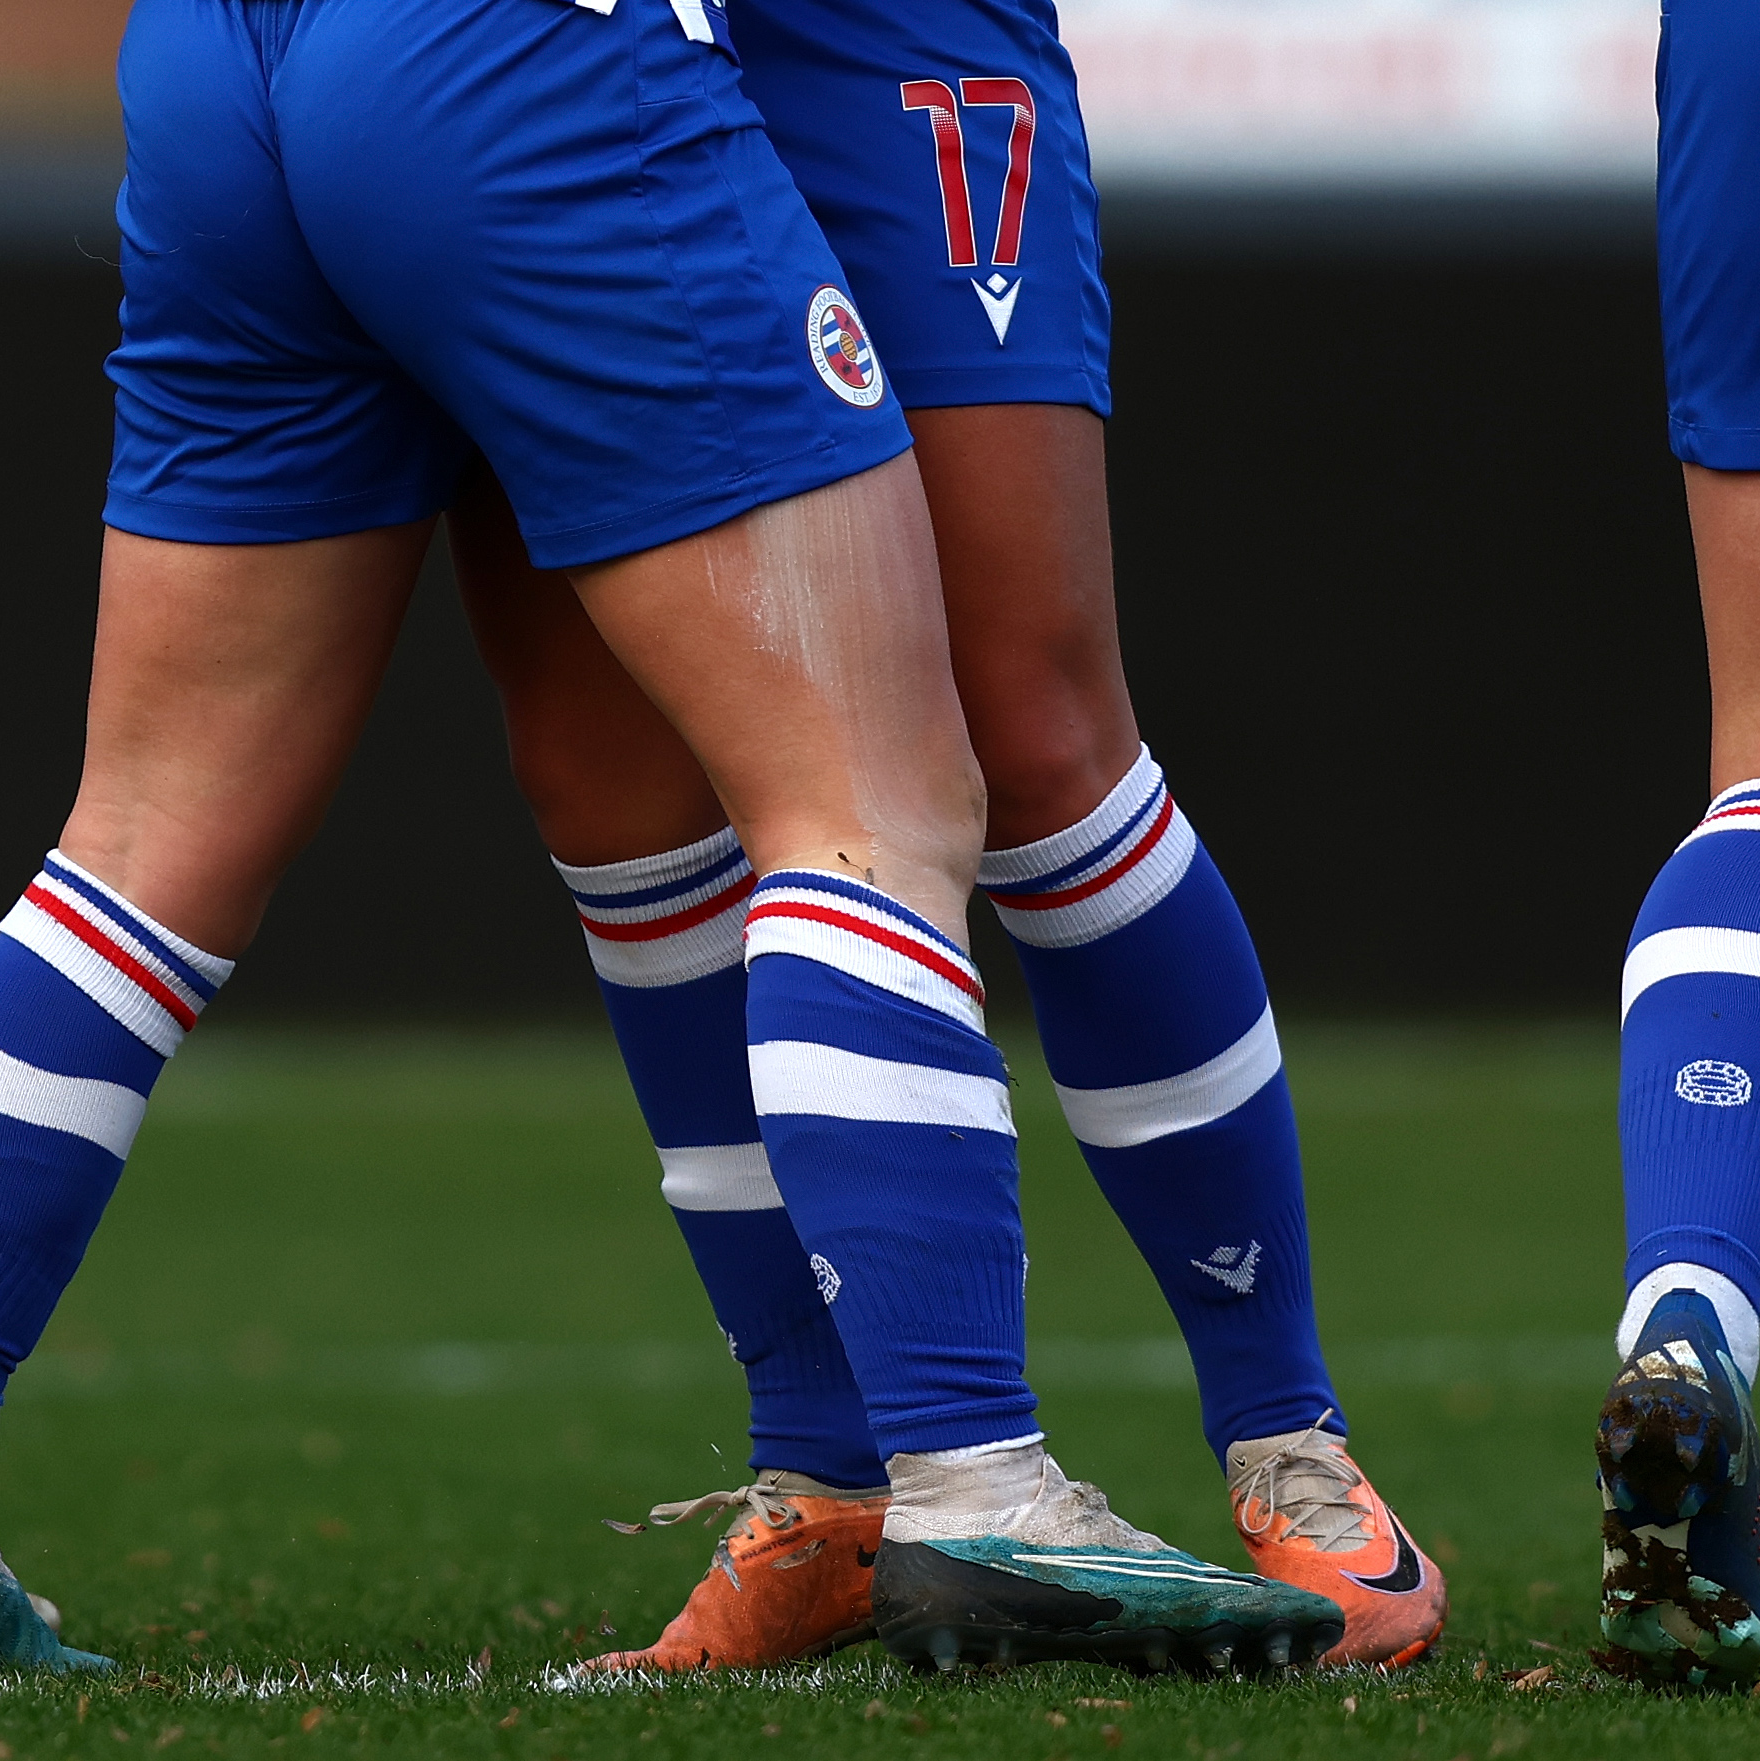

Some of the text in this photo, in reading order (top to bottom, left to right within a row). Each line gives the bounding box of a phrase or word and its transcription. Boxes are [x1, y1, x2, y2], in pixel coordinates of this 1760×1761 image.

[899, 77, 1036, 268] 17
[809, 308, 829, 374] READING
[853, 390, 872, 403] EST.
